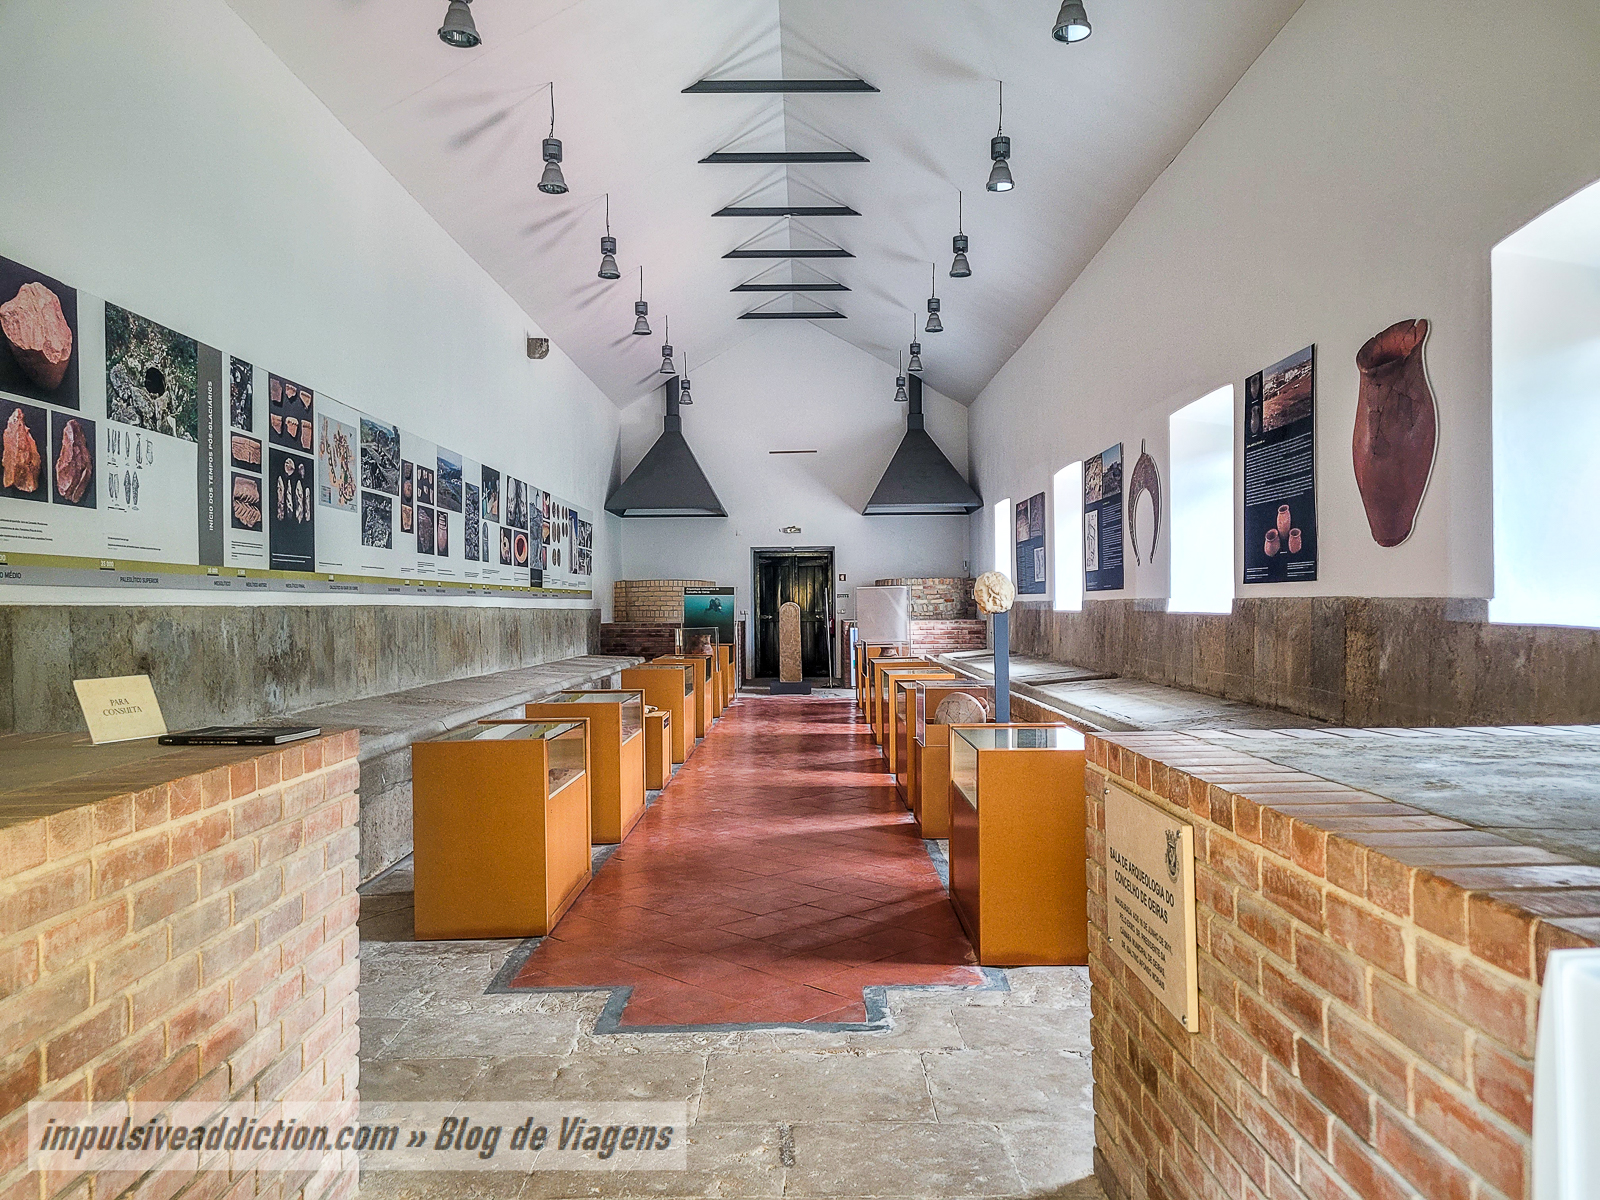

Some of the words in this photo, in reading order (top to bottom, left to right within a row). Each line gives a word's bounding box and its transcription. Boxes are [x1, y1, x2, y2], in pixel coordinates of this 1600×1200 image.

[4, 570, 22, 580] MÉDIO
[102, 705, 143, 717] CONSULTA
[109, 698, 130, 706] PARA
[1109, 847, 1121, 864] SALA
[1122, 857, 1127, 870] DE
[1128, 862, 1164, 900] ARQUEOLOGIA
[1166, 892, 1174, 908] DO
[1114, 869, 1139, 899] CONCELHO
[1140, 892, 1146, 905] DE
[1148, 898, 1168, 924] OEIRAS
[1141, 933, 1160, 957] PRESIDENTE
